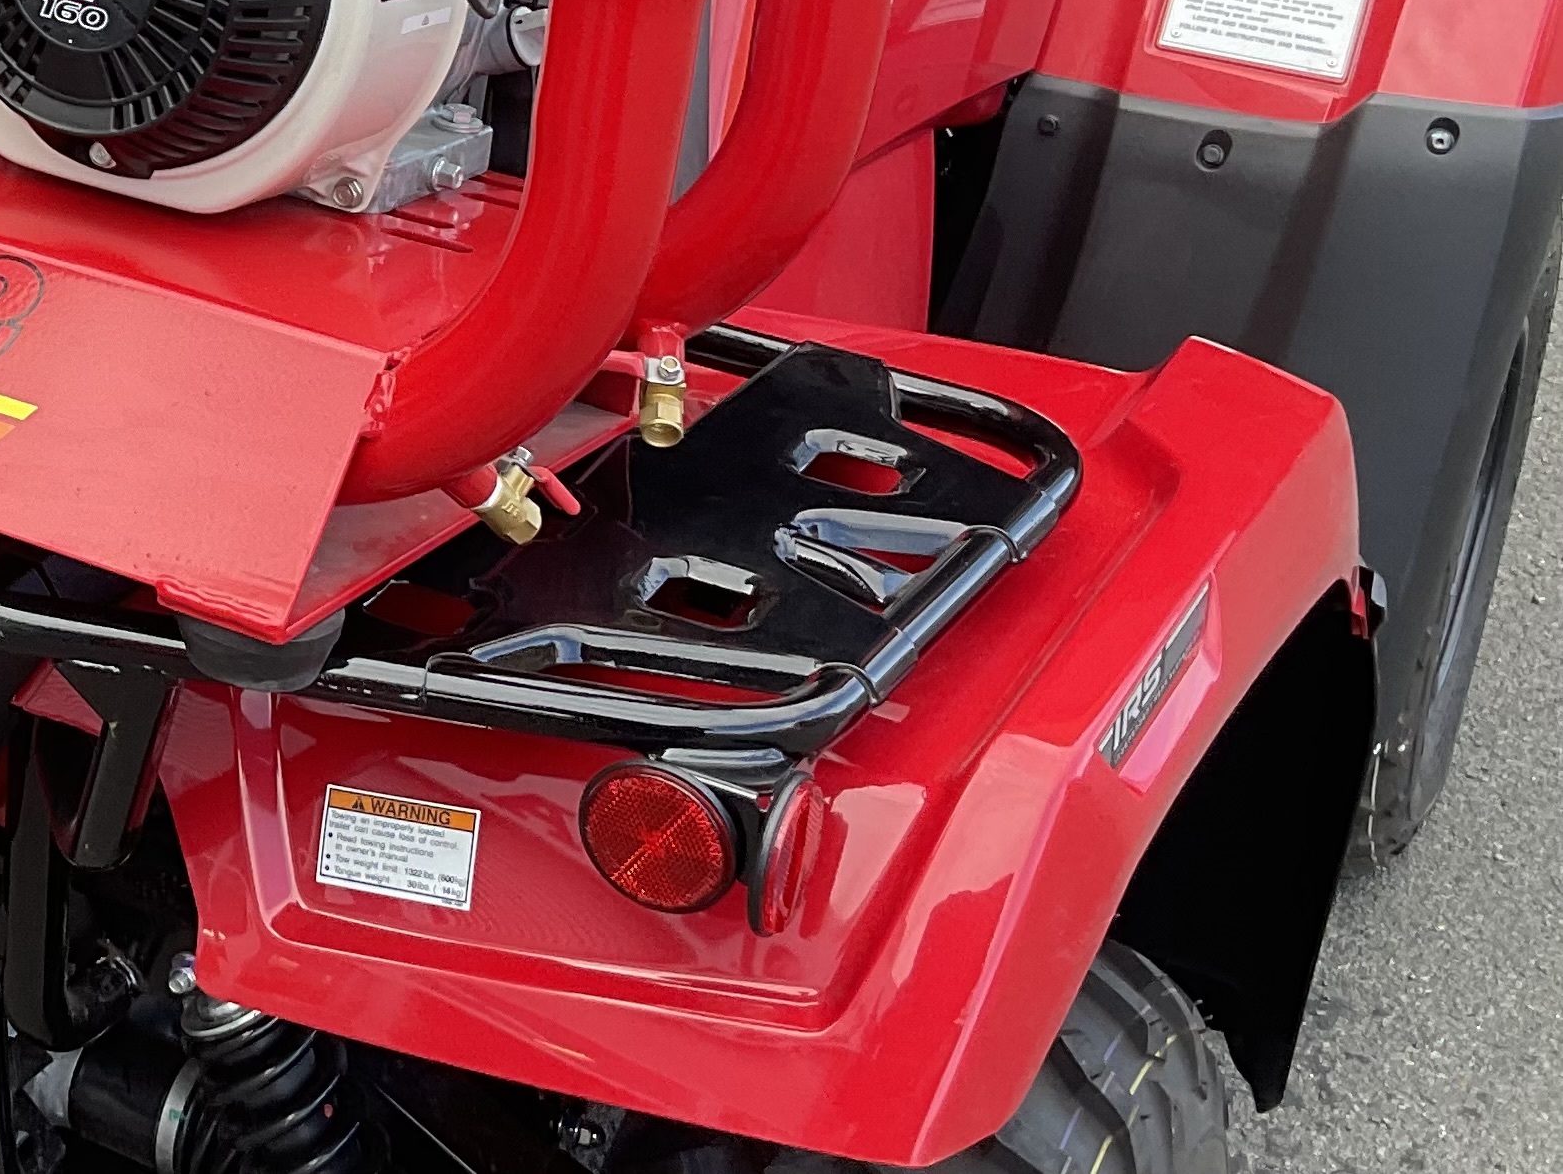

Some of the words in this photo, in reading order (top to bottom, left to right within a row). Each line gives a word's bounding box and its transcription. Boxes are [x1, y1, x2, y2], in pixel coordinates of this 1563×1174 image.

[371, 797, 450, 825] WARNING
[329, 820, 351, 830] trailer
[354, 826, 368, 834] can
[372, 829, 395, 838] cause
[399, 832, 415, 842] loss
[418, 836, 427, 844] of
[331, 810, 357, 824] Towing
[374, 819, 413, 834] improperly
[418, 826, 445, 837] loaded
[337, 832, 357, 843] Read
[361, 837, 385, 851] towing
[389, 843, 434, 858] instructions
[335, 853, 350, 863] Tow
[354, 859, 379, 870] weight
[379, 852, 408, 863] manual
[334, 865, 362, 878] Tongue
